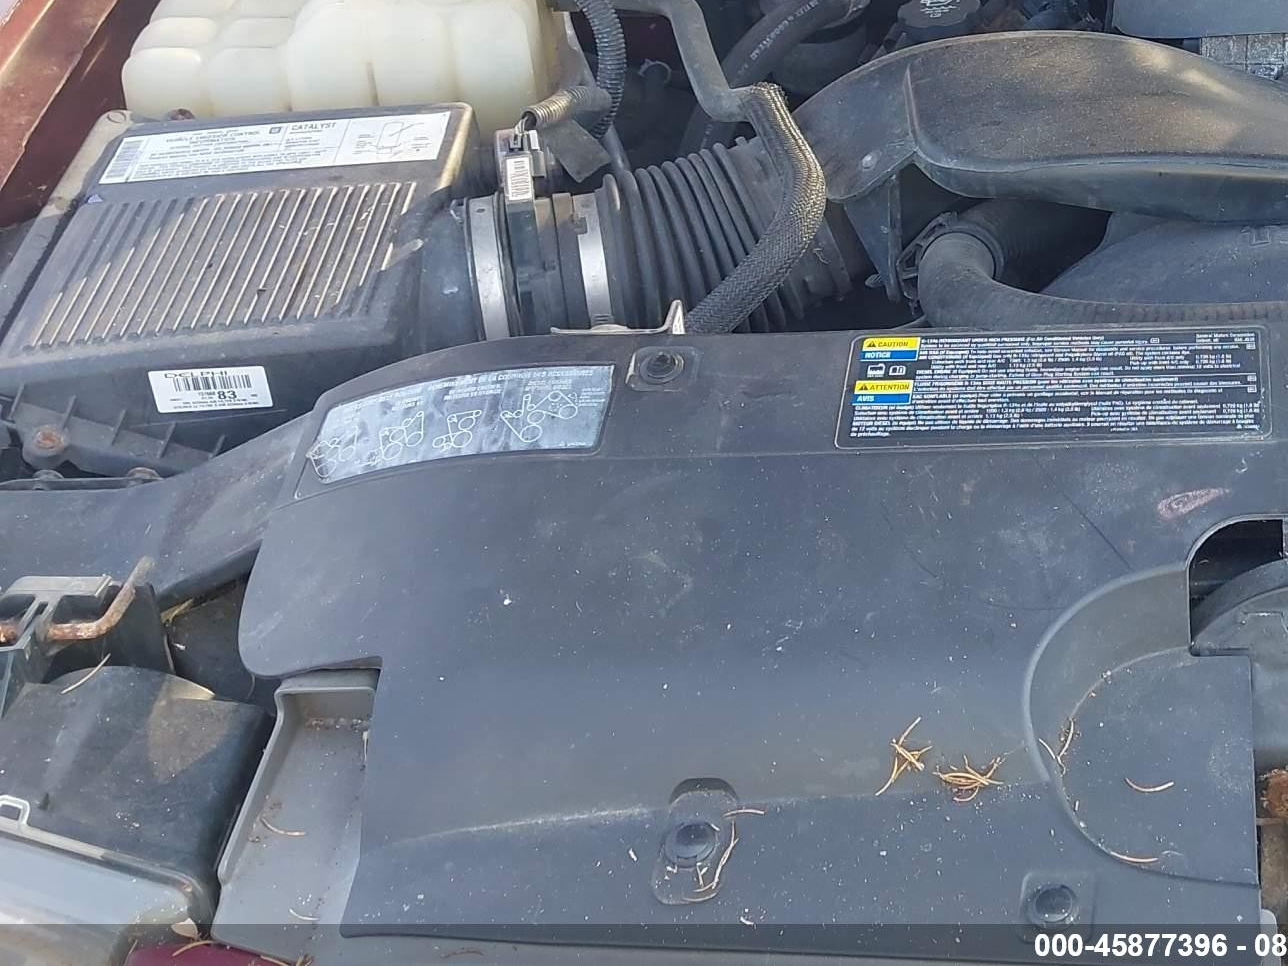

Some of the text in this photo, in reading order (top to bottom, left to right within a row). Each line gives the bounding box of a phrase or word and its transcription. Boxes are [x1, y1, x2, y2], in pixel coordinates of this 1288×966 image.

[291, 122, 337, 131] CATALYST
[864, 351, 892, 359] NOTICE
[164, 370, 228, 379] DELPHI
[869, 383, 910, 391] ATTENTION
[216, 390, 237, 400] 83
